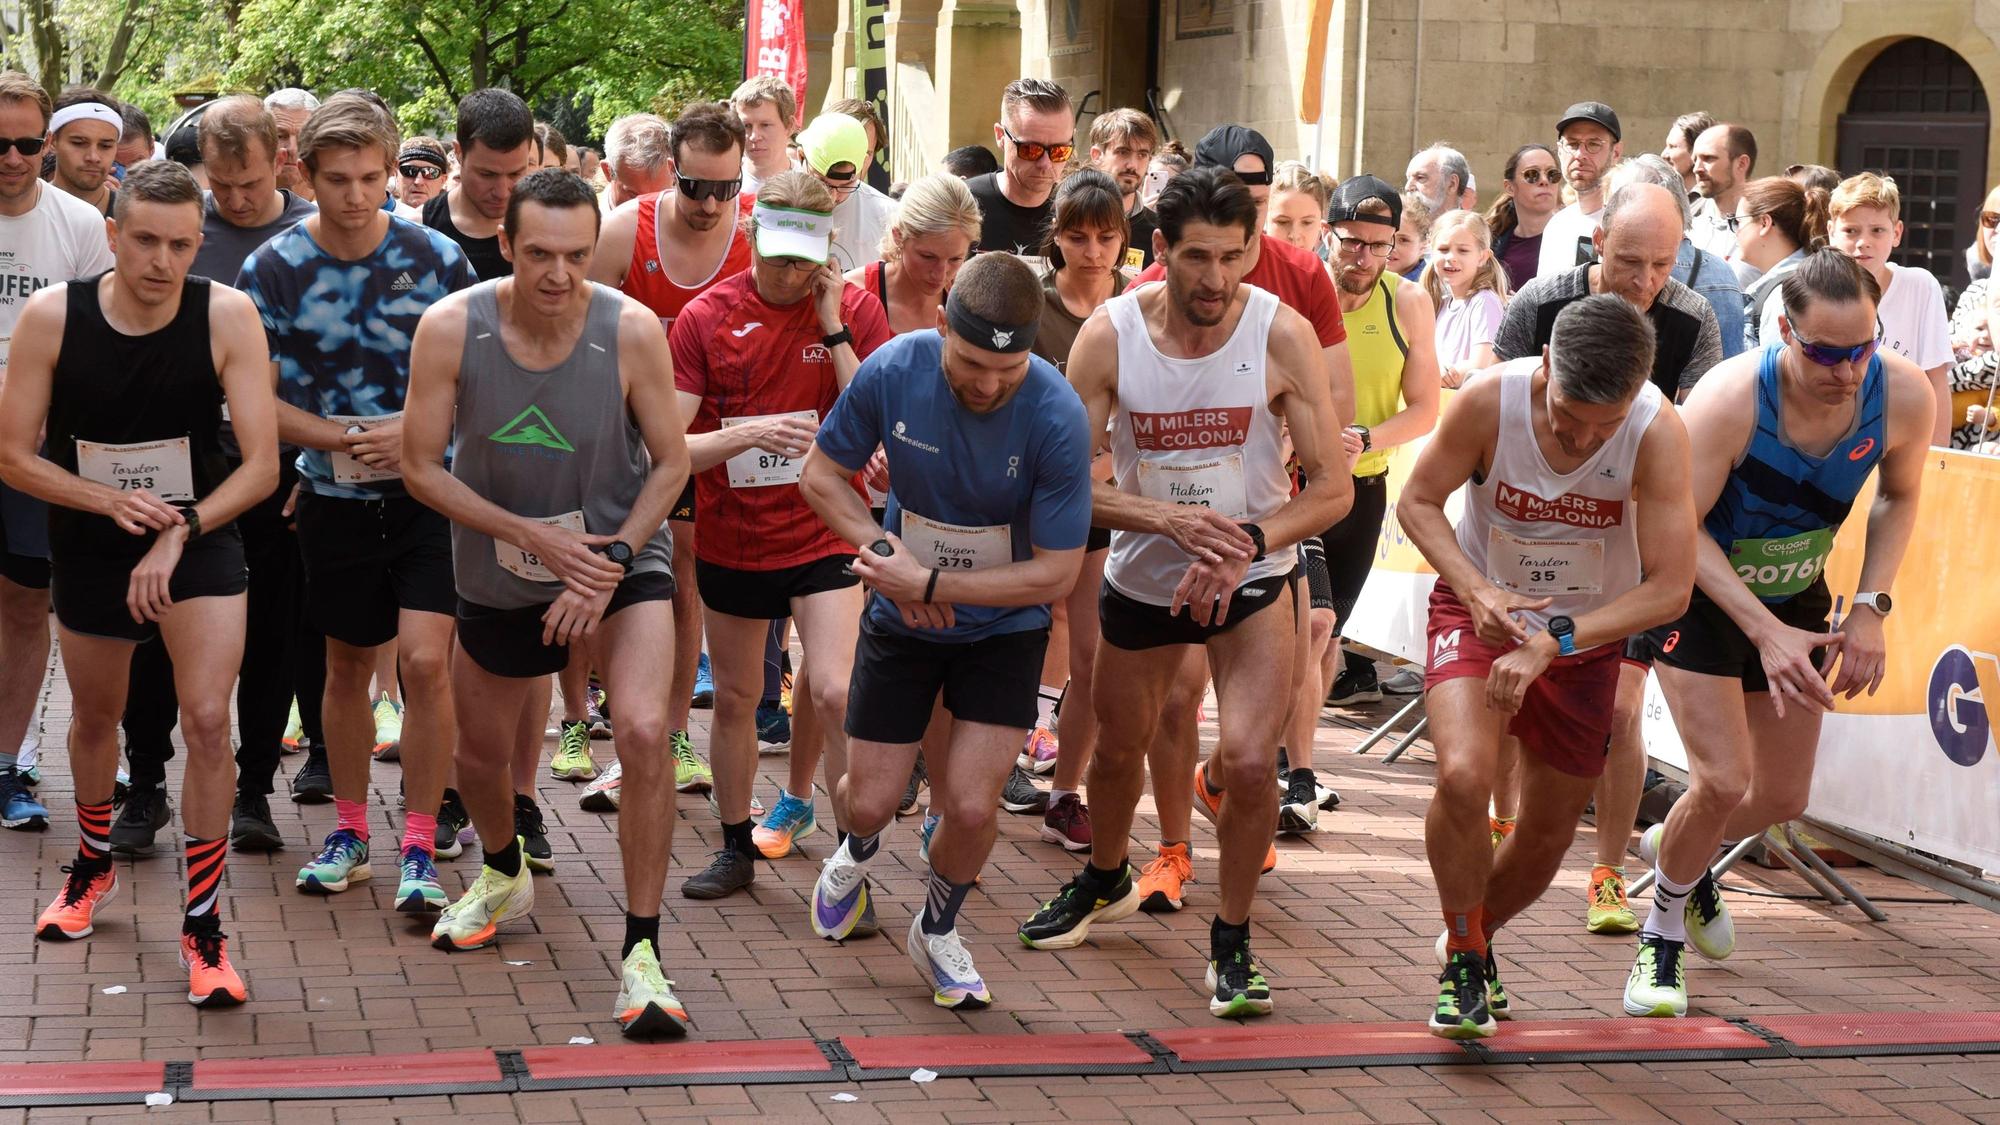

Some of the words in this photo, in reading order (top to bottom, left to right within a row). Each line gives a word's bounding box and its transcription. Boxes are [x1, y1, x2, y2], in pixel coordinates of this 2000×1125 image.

[391, 283, 417, 291] adidas
[803, 349, 825, 359] LAZ
[1160, 412, 1228, 431] MILERS
[1160, 429, 1244, 447] COLONIA
[111, 462, 160, 475] Torsten
[759, 455, 789, 469] 872
[118, 477, 154, 490] 753
[1169, 482, 1215, 496] Hakim
[1527, 495, 1597, 512] MILERS
[1525, 508, 1616, 527] COLONIA
[933, 540, 976, 558] Hagen
[1768, 538, 1812, 551] COLOGNE
[521, 552, 545, 566] 13
[938, 556, 973, 569] 379
[1519, 554, 1572, 567] Torsten
[1530, 570, 1556, 582] 35
